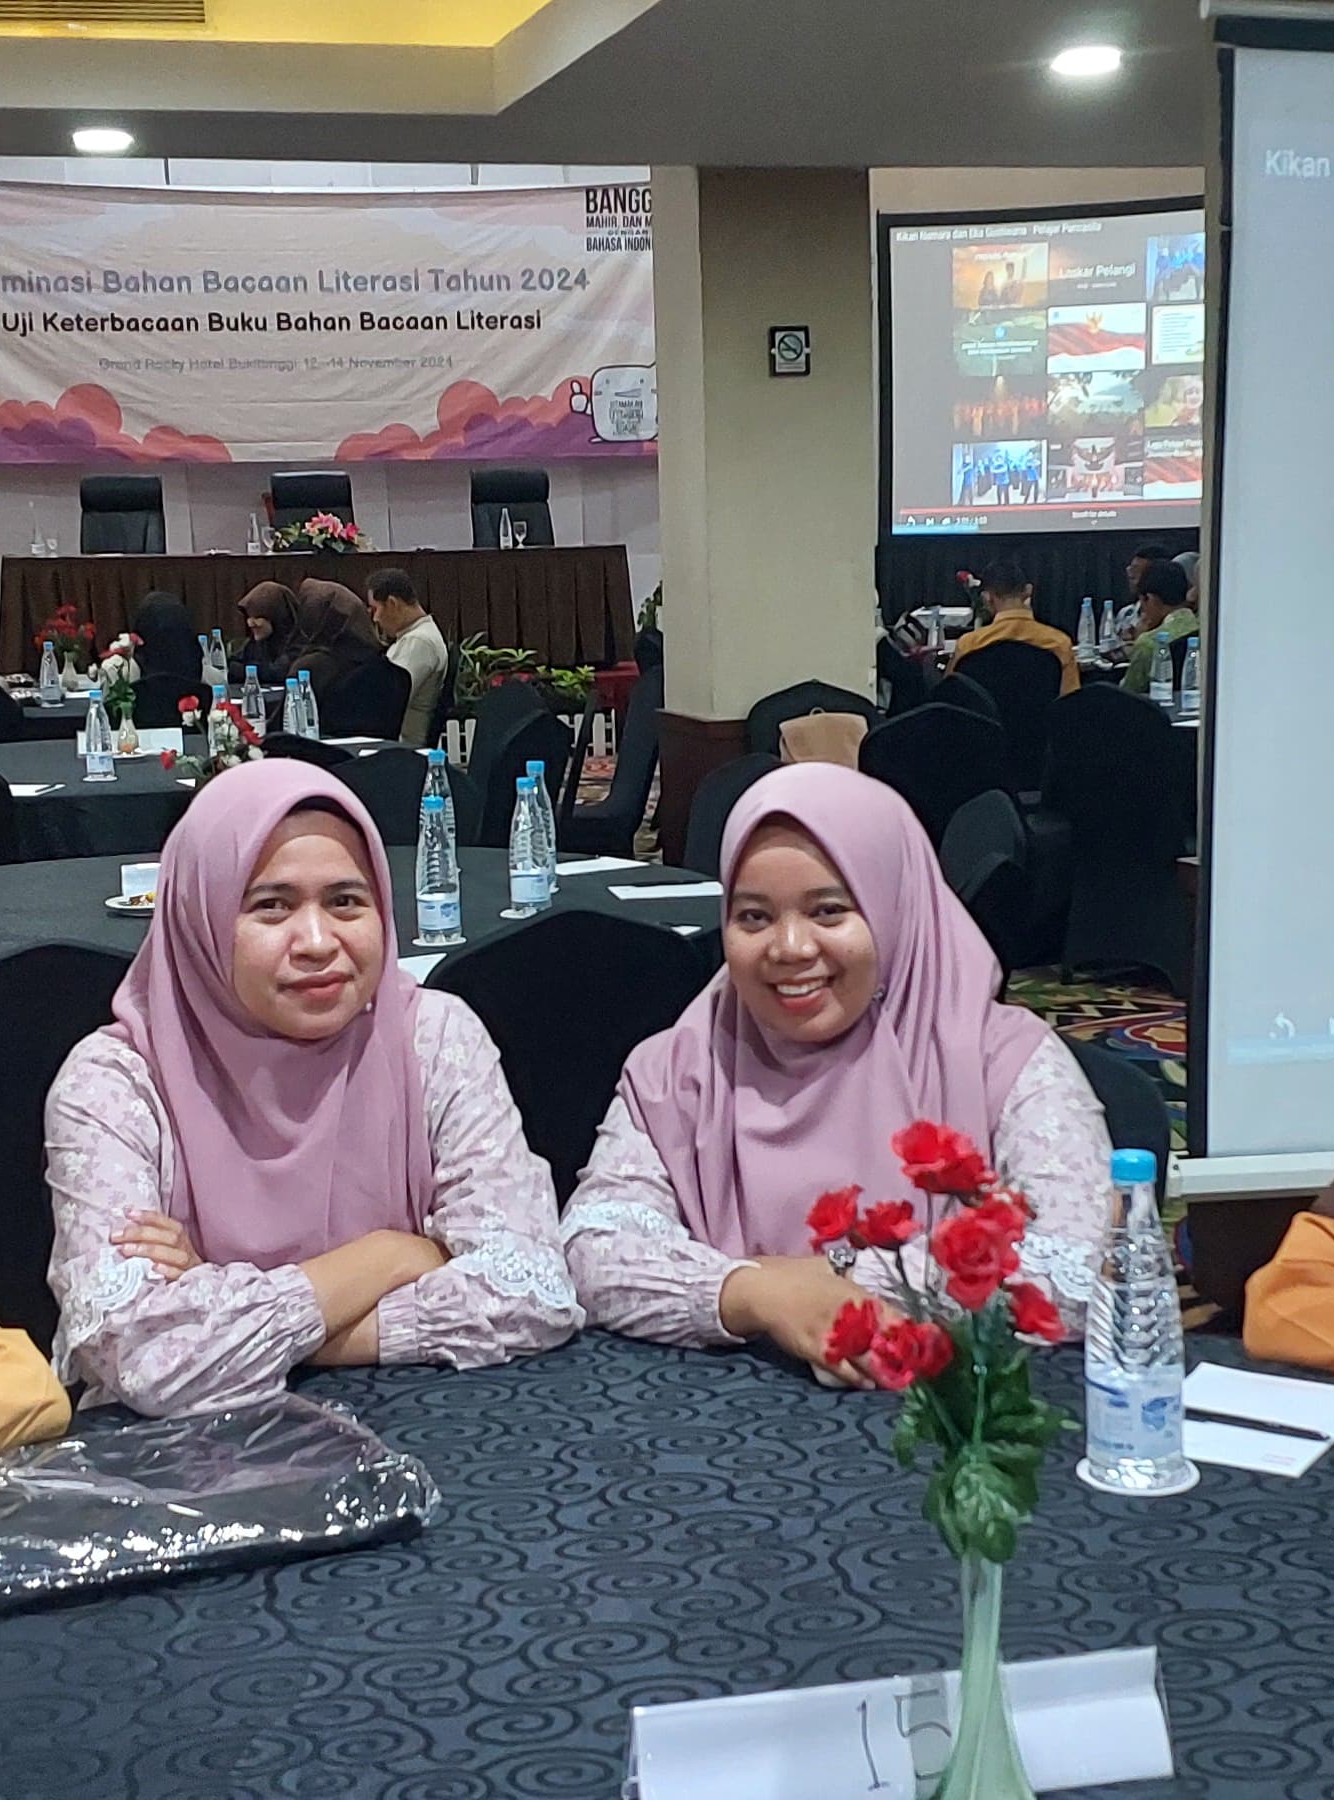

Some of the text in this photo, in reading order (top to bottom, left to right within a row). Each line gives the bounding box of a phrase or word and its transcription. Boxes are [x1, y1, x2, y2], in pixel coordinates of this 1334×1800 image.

[1265, 149, 1331, 178] Kikan
[586, 236, 623, 252] BAHASA
[102, 269, 193, 294] Bahan
[202, 269, 308, 293] Bacaan
[318, 268, 421, 293] Literasi
[427, 268, 512, 291] Tahun
[520, 267, 589, 291] 2024
[1, 309, 542, 337] Uji Keterbacaan Buku Bahan Bacaan Literasi
